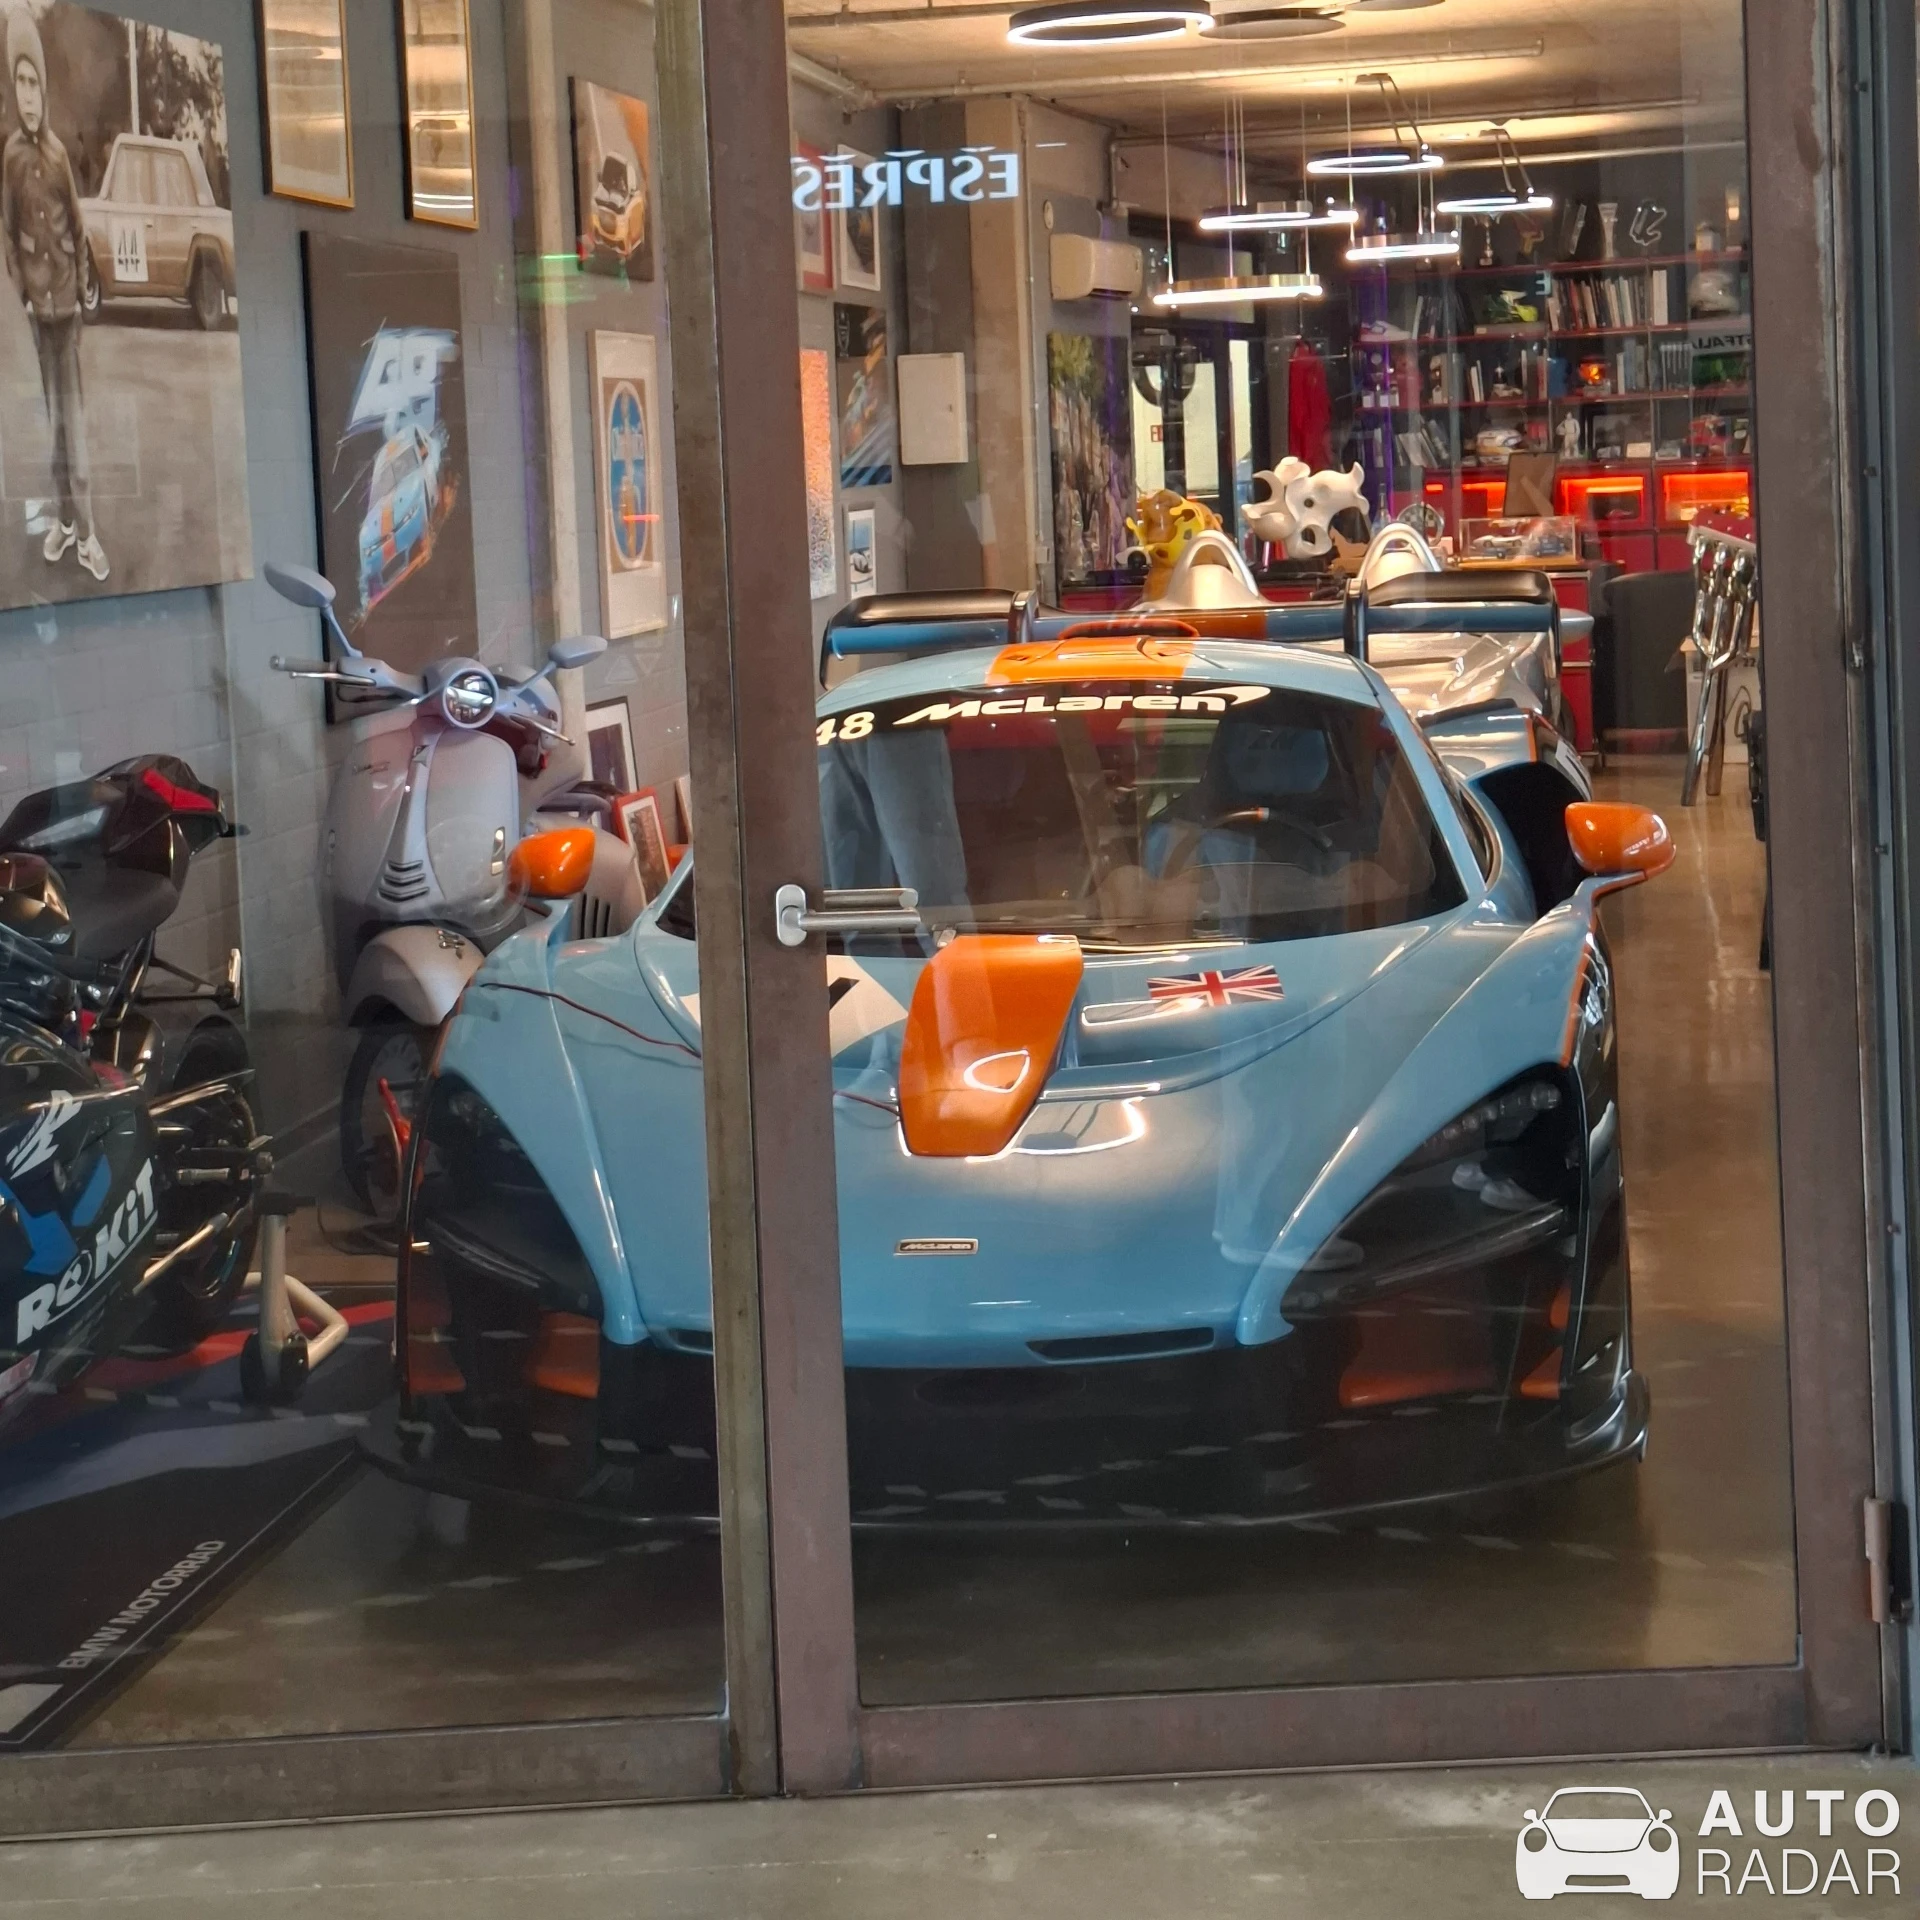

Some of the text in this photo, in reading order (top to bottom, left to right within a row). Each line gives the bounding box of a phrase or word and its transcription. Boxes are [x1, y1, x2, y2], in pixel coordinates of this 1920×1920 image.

[894, 695, 1226, 725] McLaren
[56, 1540, 226, 1668] BMW MOTORRAD
